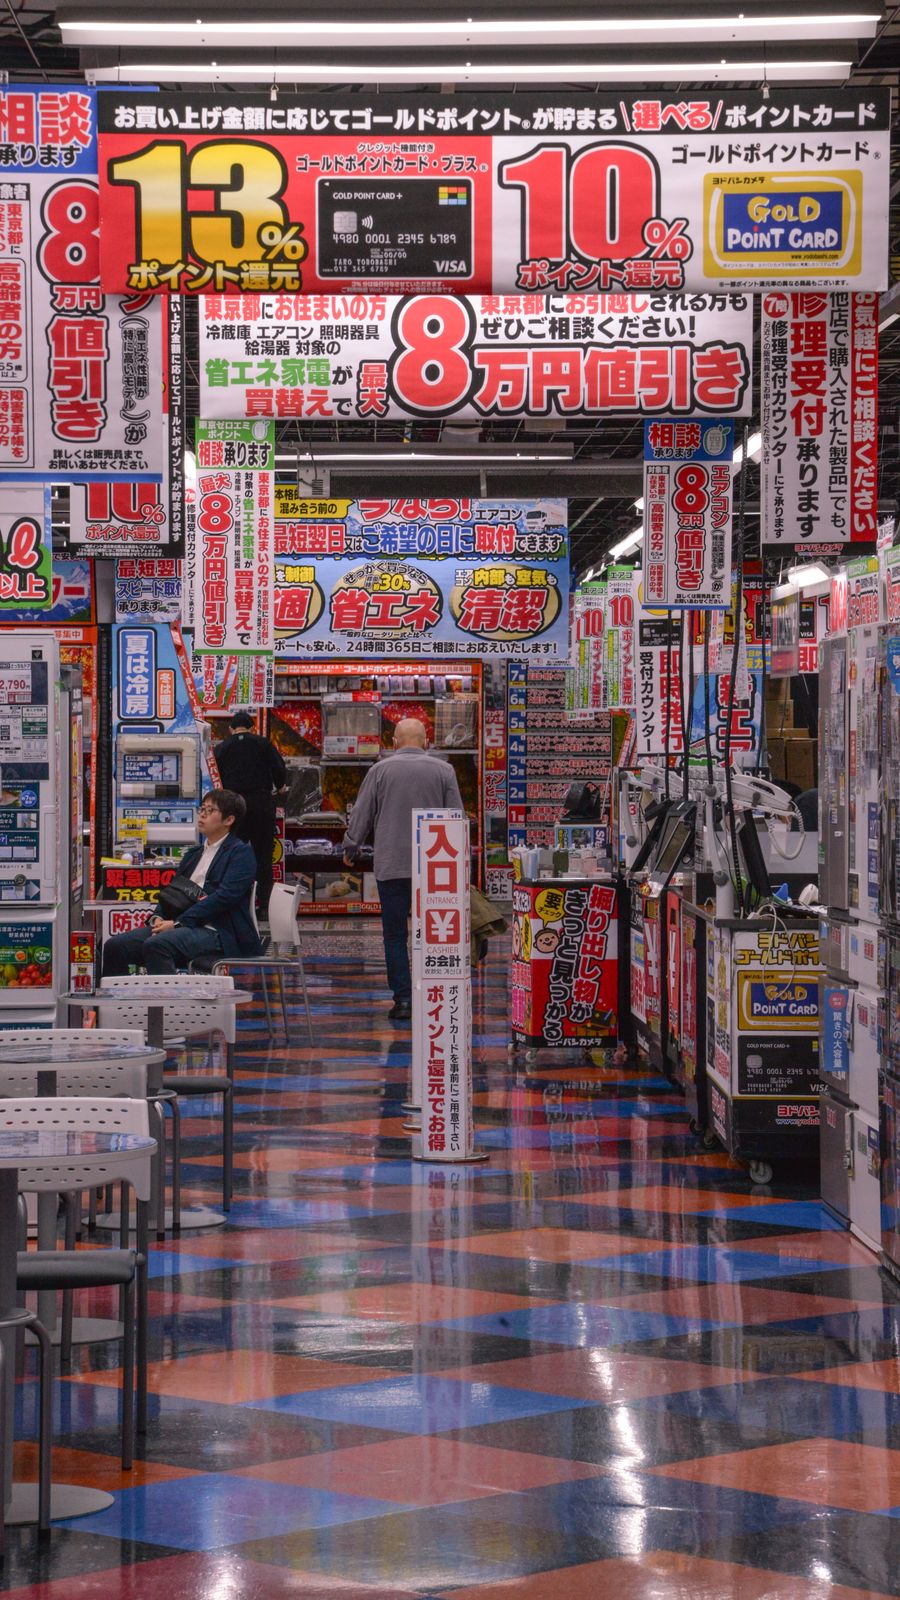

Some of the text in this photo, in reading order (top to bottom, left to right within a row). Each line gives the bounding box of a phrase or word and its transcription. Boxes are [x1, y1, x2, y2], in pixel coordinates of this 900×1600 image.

[725, 103, 878, 128] ポイントカード
[356, 142, 436, 154] クレジット機能付き
[712, 176, 766, 185] ヨドバシカメラ
[107, 138, 308, 265] 13%
[333, 192, 353, 200] GOLD
[353, 192, 375, 200] POINT
[376, 192, 396, 200] CARD
[498, 140, 693, 264] 10%
[7, 203, 24, 254] 東京都に
[36, 177, 100, 284] 8
[332, 233, 457, 244] 4980 0001 2345 6789
[129, 261, 301, 291] ポイント還元
[432, 260, 467, 273] VISA
[519, 261, 684, 290] ポイント還元
[54, 285, 101, 311] 万円
[203, 294, 387, 322] 東京都にお住まいの方
[479, 294, 748, 316] 東京都にお引越しされる方も
[205, 325, 380, 341] 冷蔵庫 エアコン 照明器具
[480, 315, 697, 340] ぜひご相談ください!
[244, 341, 341, 356] 給湯器 対象の
[391, 294, 477, 418] 8
[48, 316, 106, 441] 値引き
[205, 357, 353, 388] 省エネ家電が
[472, 342, 750, 414] 万円値引き
[244, 388, 353, 418] 買替えで
[207, 430, 241, 439] ポイント
[649, 423, 701, 448] 相談
[771, 320, 789, 539] 修理受付カウンターにて承ります
[48, 460, 149, 470] お問いあわせください
[53, 449, 144, 460] 詳しくは販売員まで
[198, 440, 272, 467] 相談承ります
[654, 447, 695, 458] 承ります
[672, 463, 709, 513] 8
[711, 465, 730, 528] エアコン
[198, 492, 234, 535] 8
[279, 503, 338, 514] 混み合う前の
[475, 509, 523, 520] エアコン
[678, 513, 704, 527] 万円
[86, 524, 161, 541] ポイント還元
[257, 472, 270, 588] 東京都にお住まいの方
[651, 503, 664, 551] 高齢者の方
[674, 528, 706, 591] 値引き
[203, 535, 227, 646] 万円値引き
[117, 601, 161, 614] 承ります
[234, 570, 254, 645] 買替えで
[330, 587, 442, 632] 省エネ
[456, 588, 549, 632] 清潔
[125, 634, 149, 715] 夏は冷房
[639, 651, 655, 752] 受付カウンター
[425, 825, 459, 894] 入口
[426, 896, 459, 905] ENTRANCE
[425, 955, 462, 968] お会計
[426, 946, 459, 954] CASHIER
[543, 888, 589, 1043] きっと見つかる
[427, 984, 446, 1153] ポイント還元でお得
